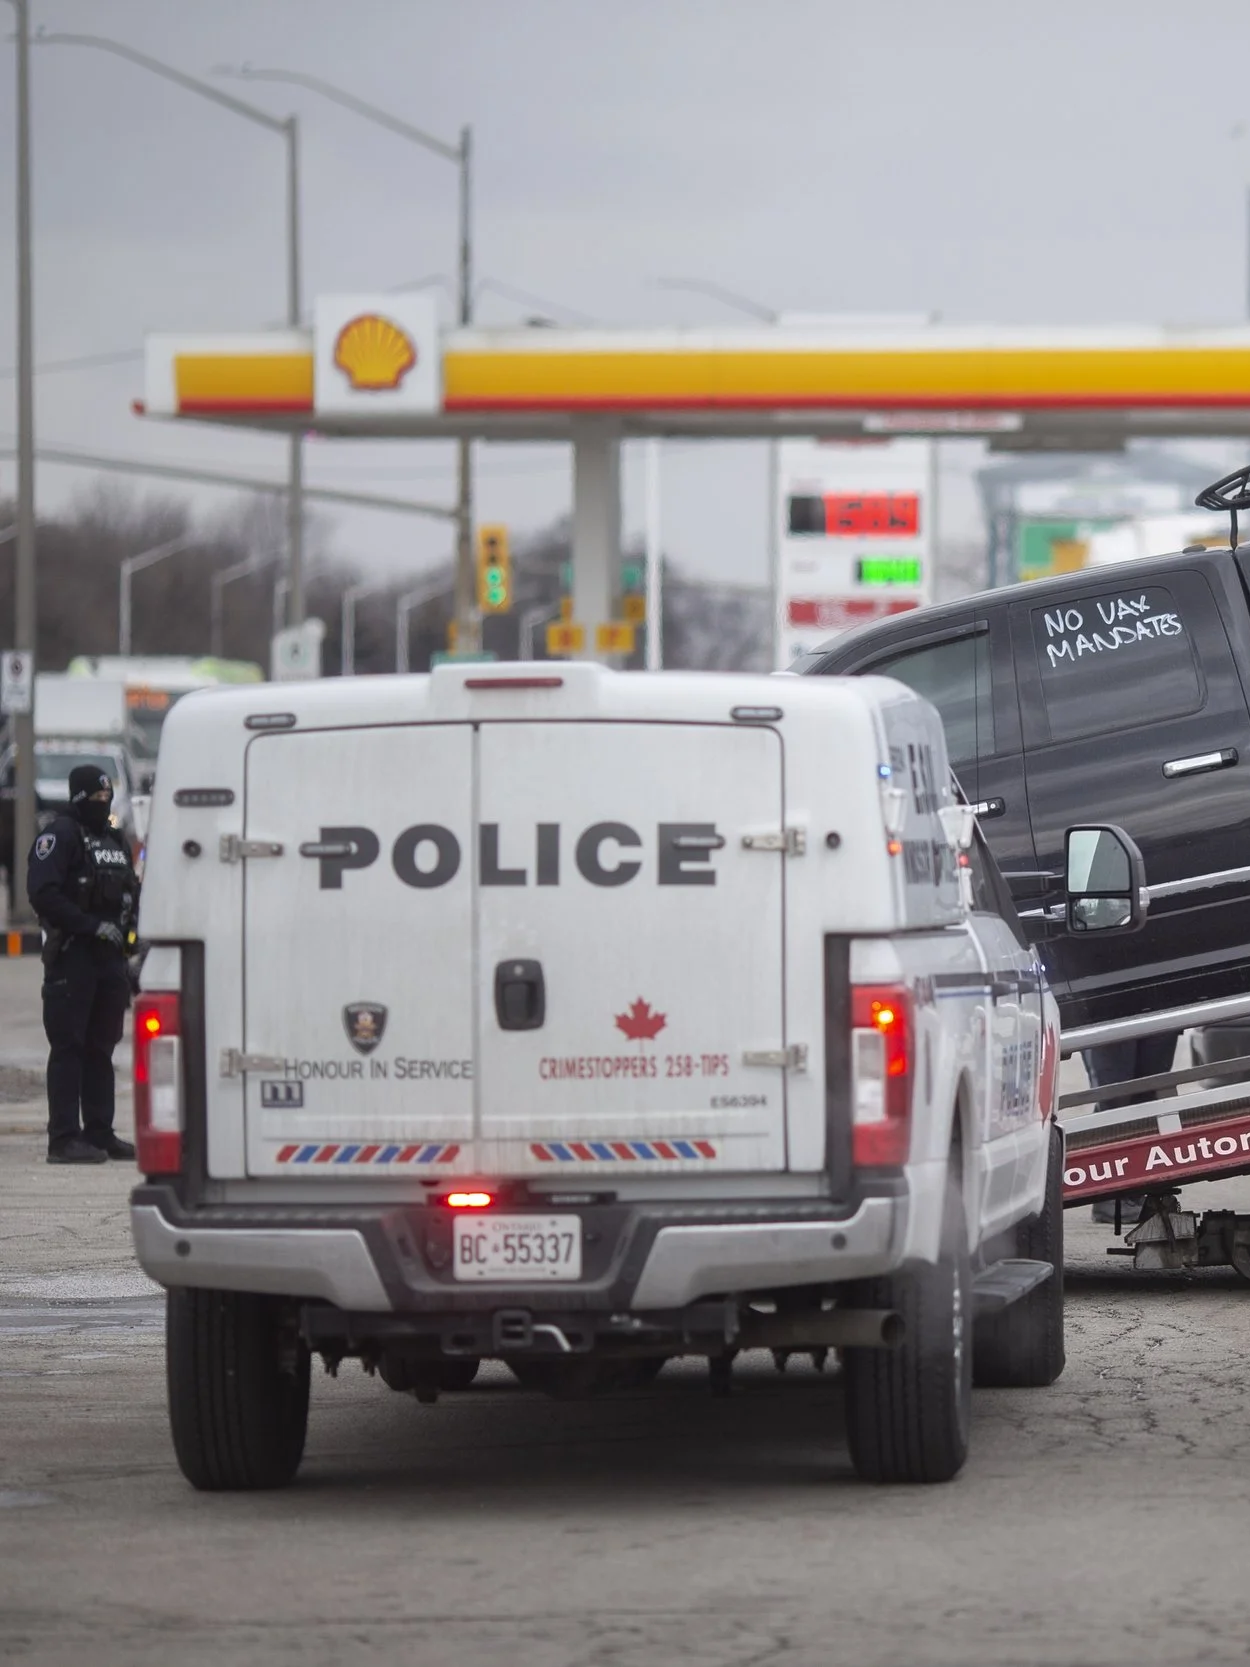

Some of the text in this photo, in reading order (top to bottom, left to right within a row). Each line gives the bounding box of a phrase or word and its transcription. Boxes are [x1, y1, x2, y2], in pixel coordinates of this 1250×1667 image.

[1043, 594, 1151, 638] NO VAX
[1046, 612, 1183, 668] MANDATES
[94, 848, 128, 865] POLICE
[318, 821, 717, 890] POLICE
[284, 1057, 364, 1080] HONOUR
[394, 1056, 474, 1080] SERVICE
[538, 1053, 730, 1080] CRIMESTOPPERS 258-TIPS
